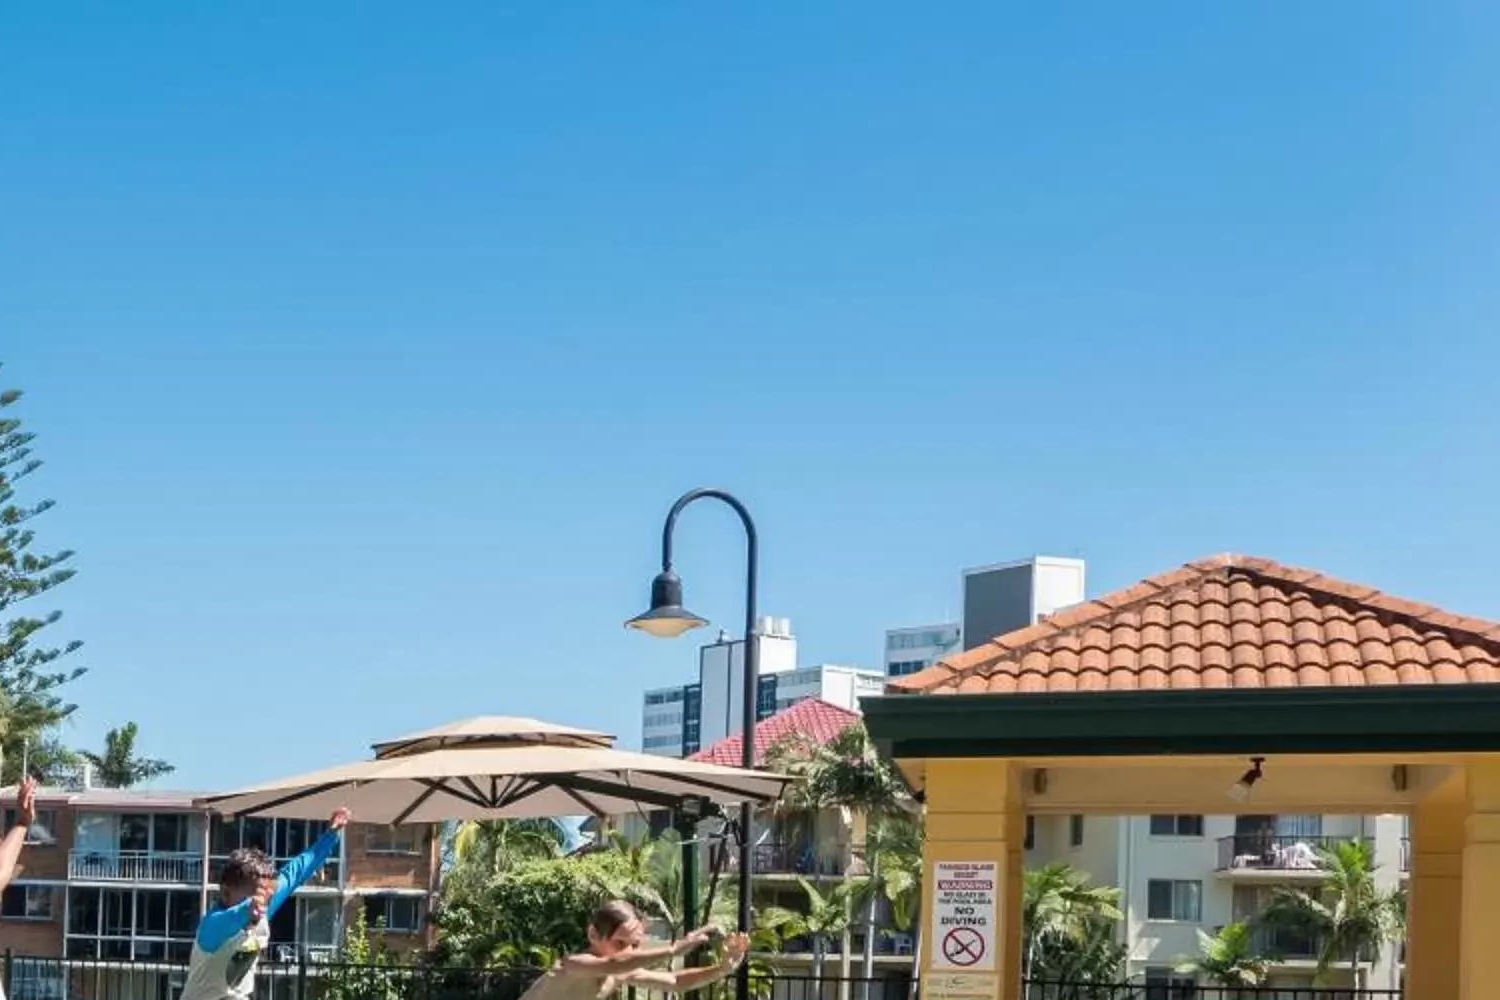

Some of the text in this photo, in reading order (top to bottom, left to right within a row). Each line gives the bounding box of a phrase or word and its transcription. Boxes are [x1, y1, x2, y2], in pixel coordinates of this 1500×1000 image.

[940, 881, 991, 889] WARNING
[955, 907, 975, 915] NO
[941, 917, 987, 926] DIVING
